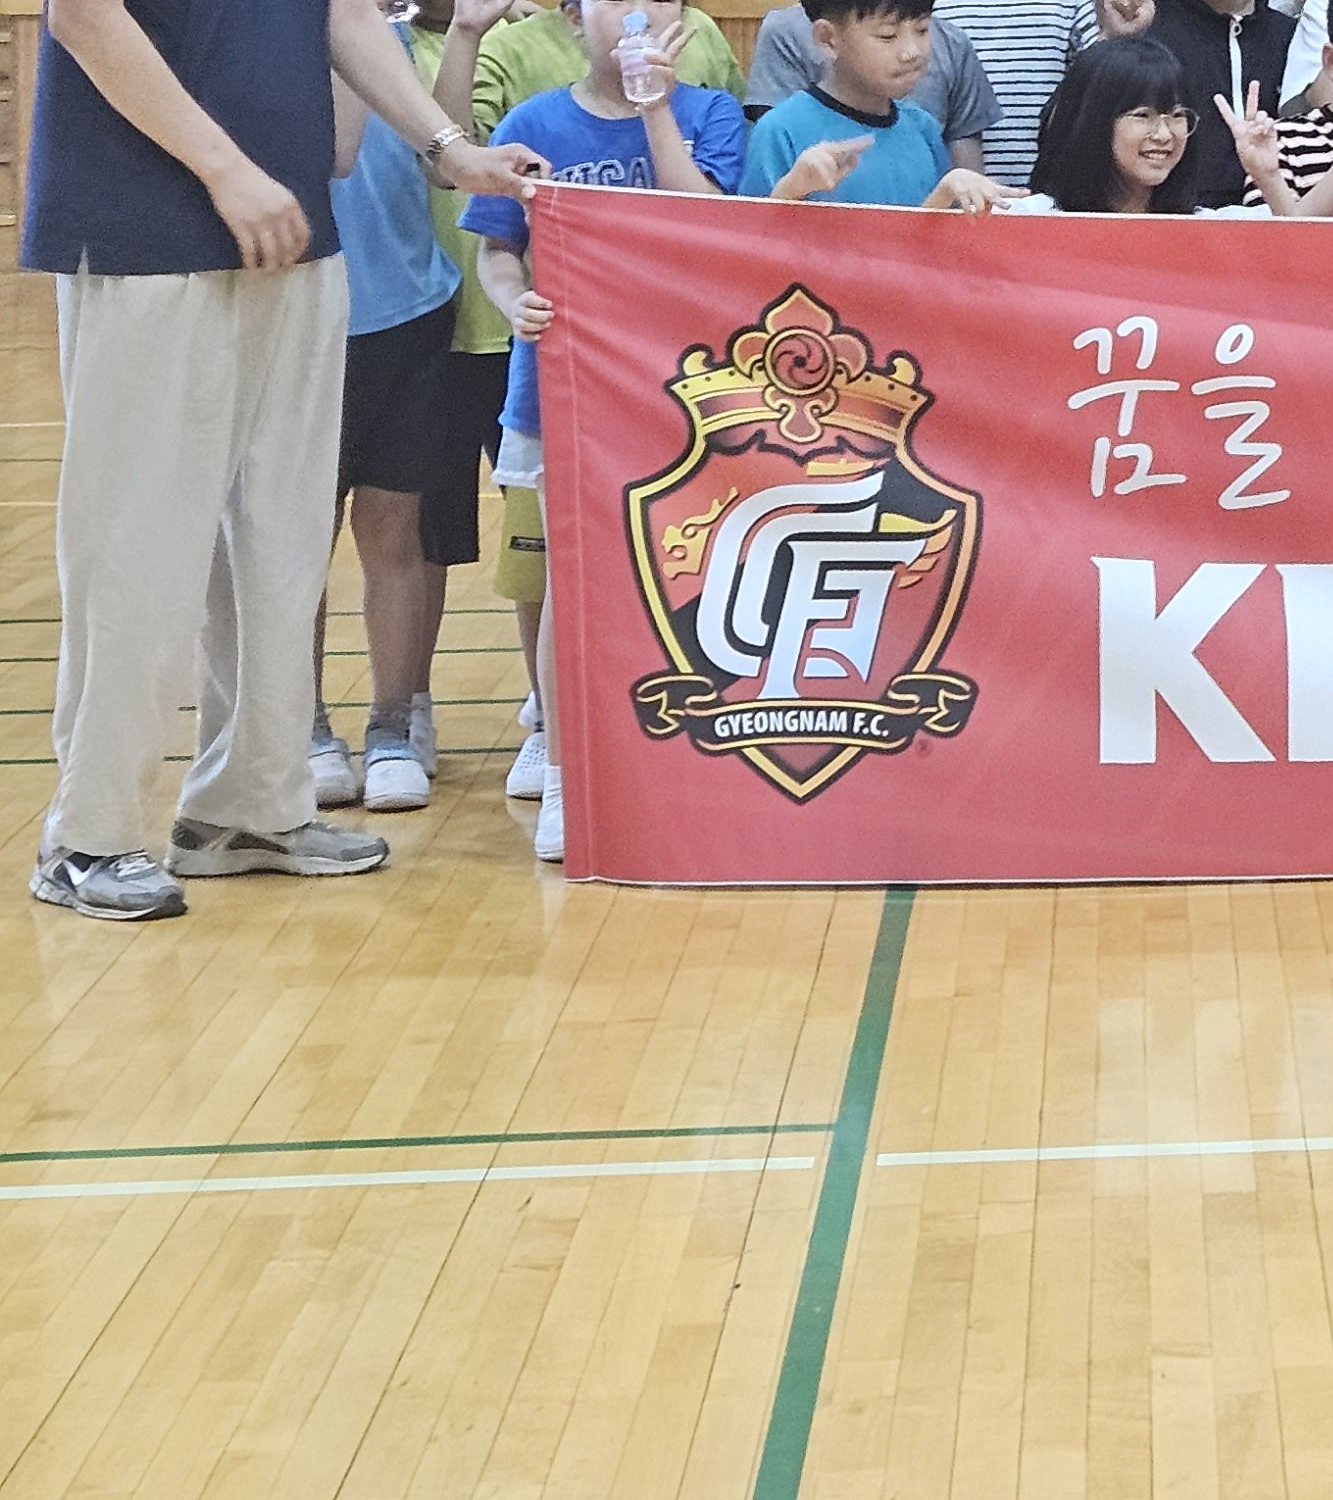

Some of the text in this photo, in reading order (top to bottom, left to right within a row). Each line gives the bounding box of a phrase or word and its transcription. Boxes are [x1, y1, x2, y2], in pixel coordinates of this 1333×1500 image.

[1067, 316, 1291, 511] 꿈을
[713, 710, 889, 738] GYEONGNAM F.C.
